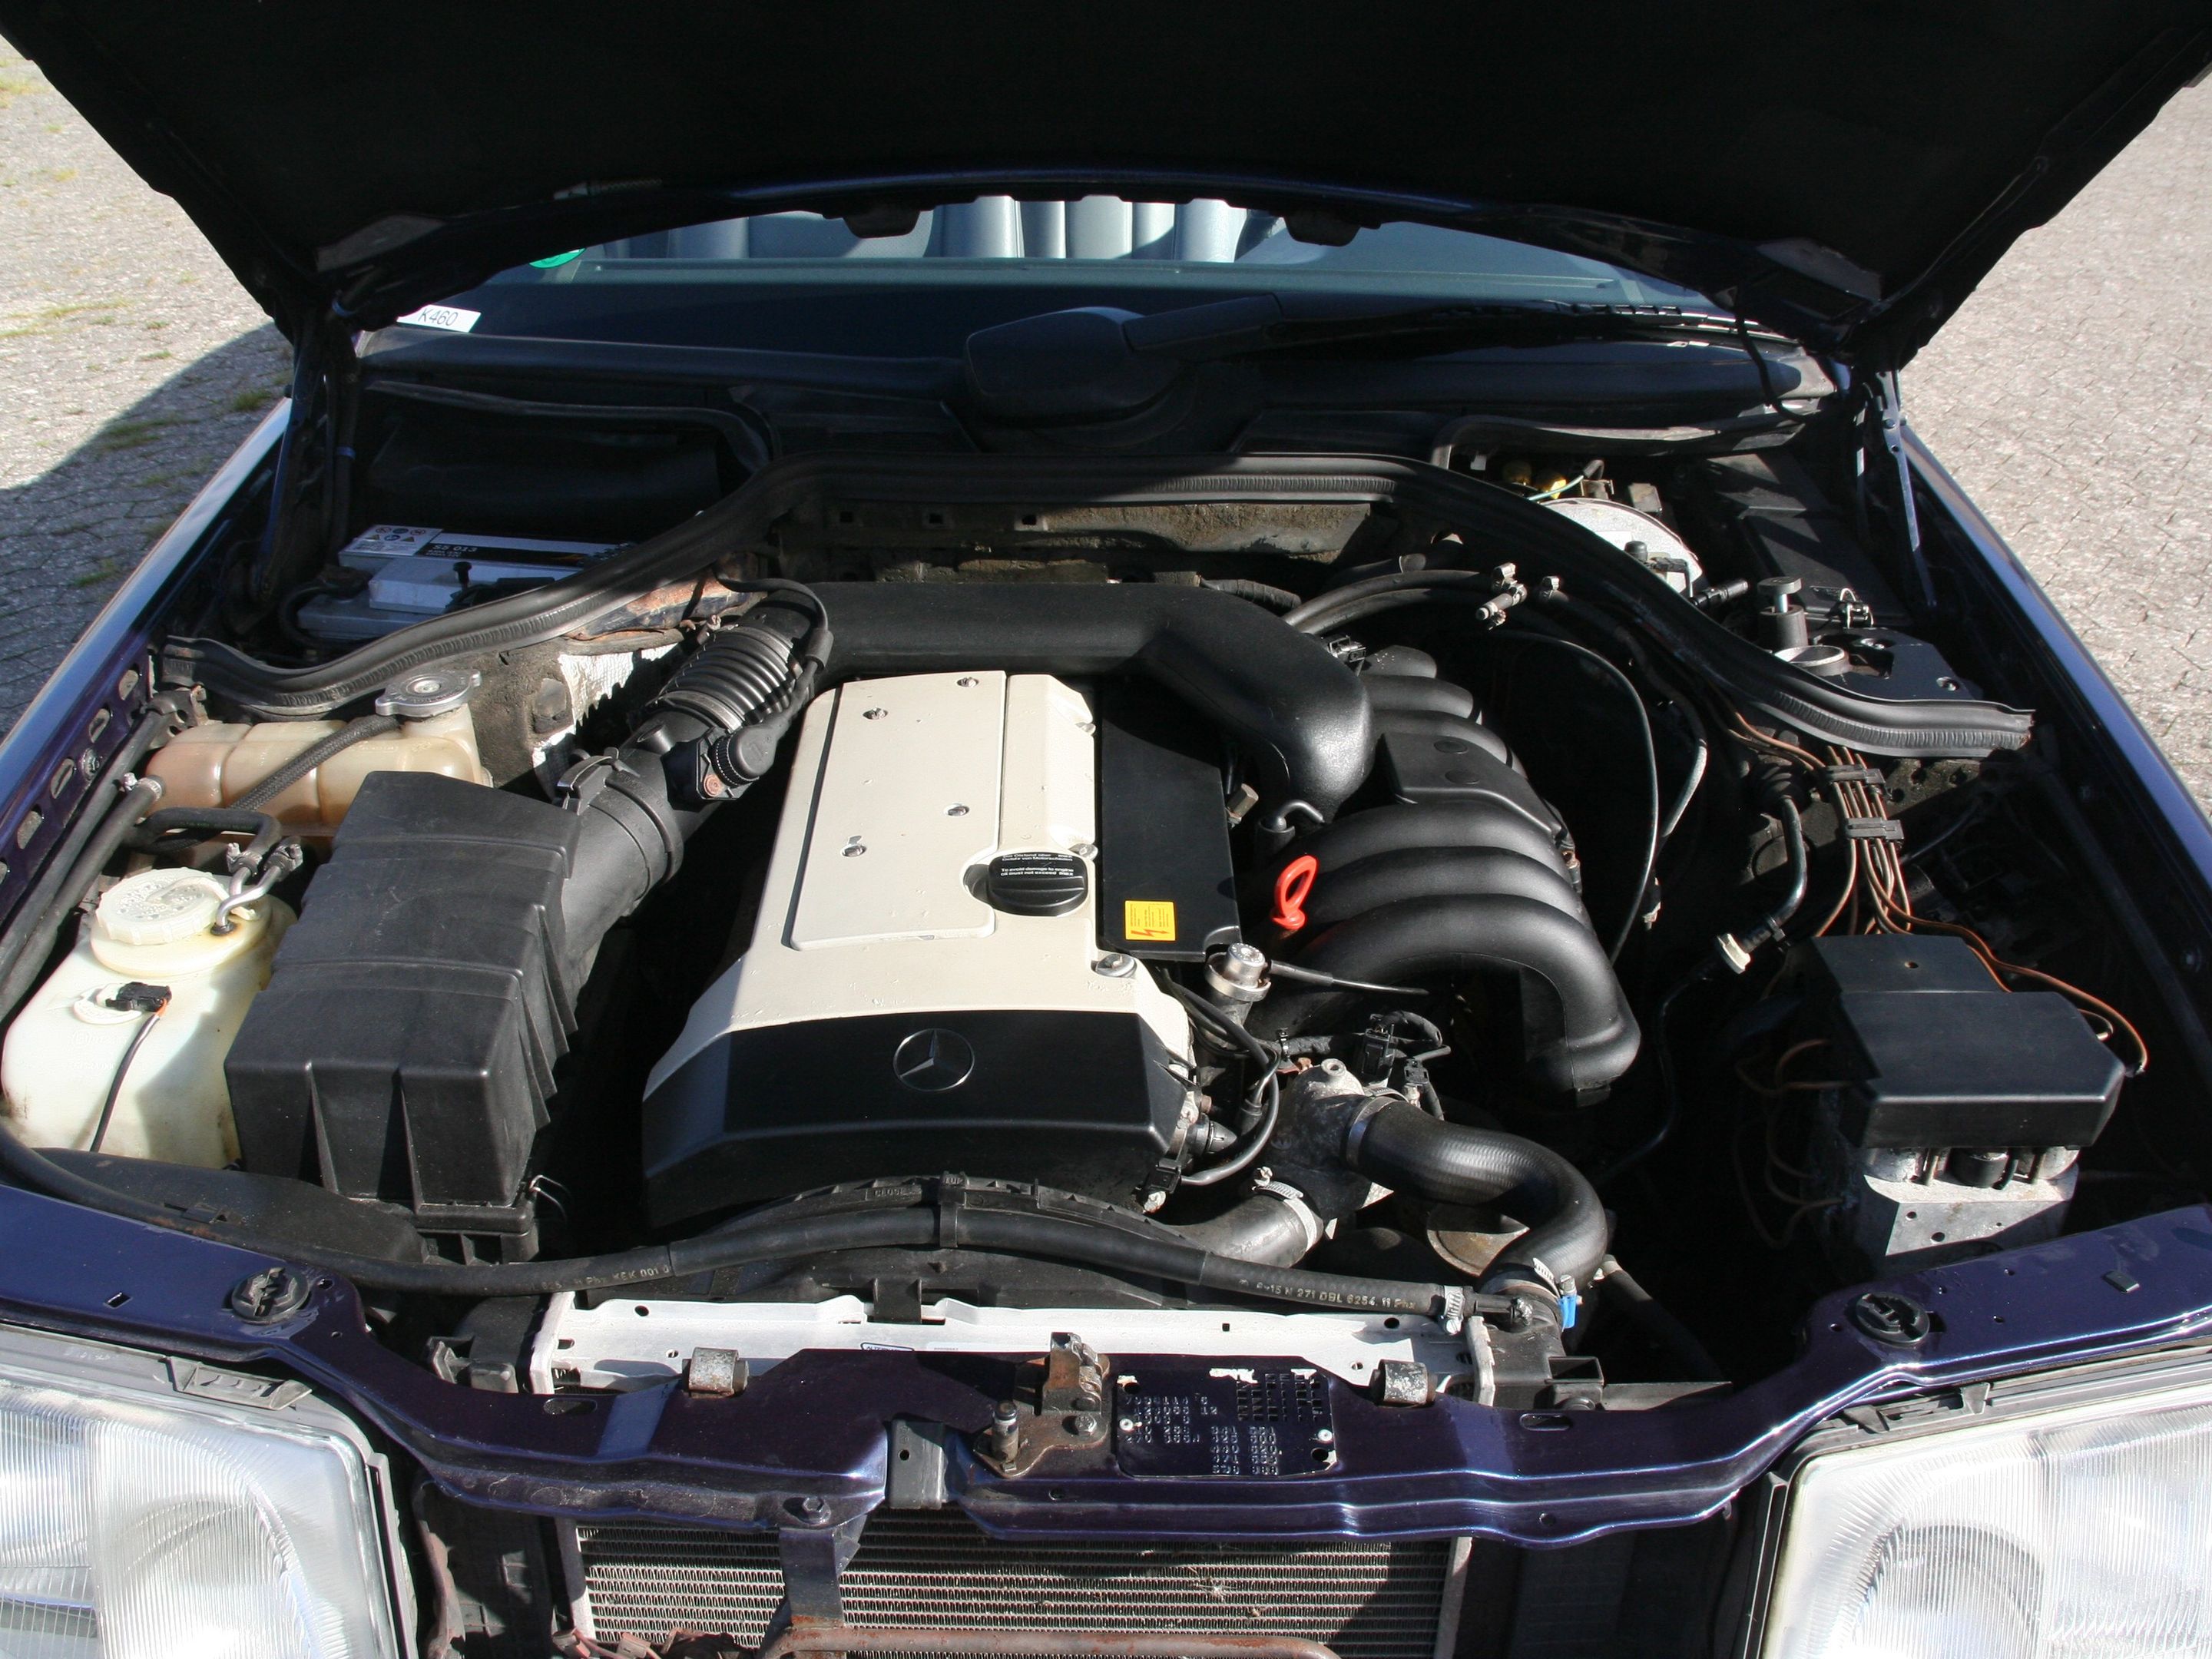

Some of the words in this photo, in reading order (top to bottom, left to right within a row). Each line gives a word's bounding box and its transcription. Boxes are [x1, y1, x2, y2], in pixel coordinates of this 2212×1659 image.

[418, 309, 459, 326] K460
[640, 1267, 660, 1278] 001
[1296, 1288, 1316, 1300] 271
[1319, 1291, 1343, 1303] DBL
[1200, 1406, 1218, 1416] 12
